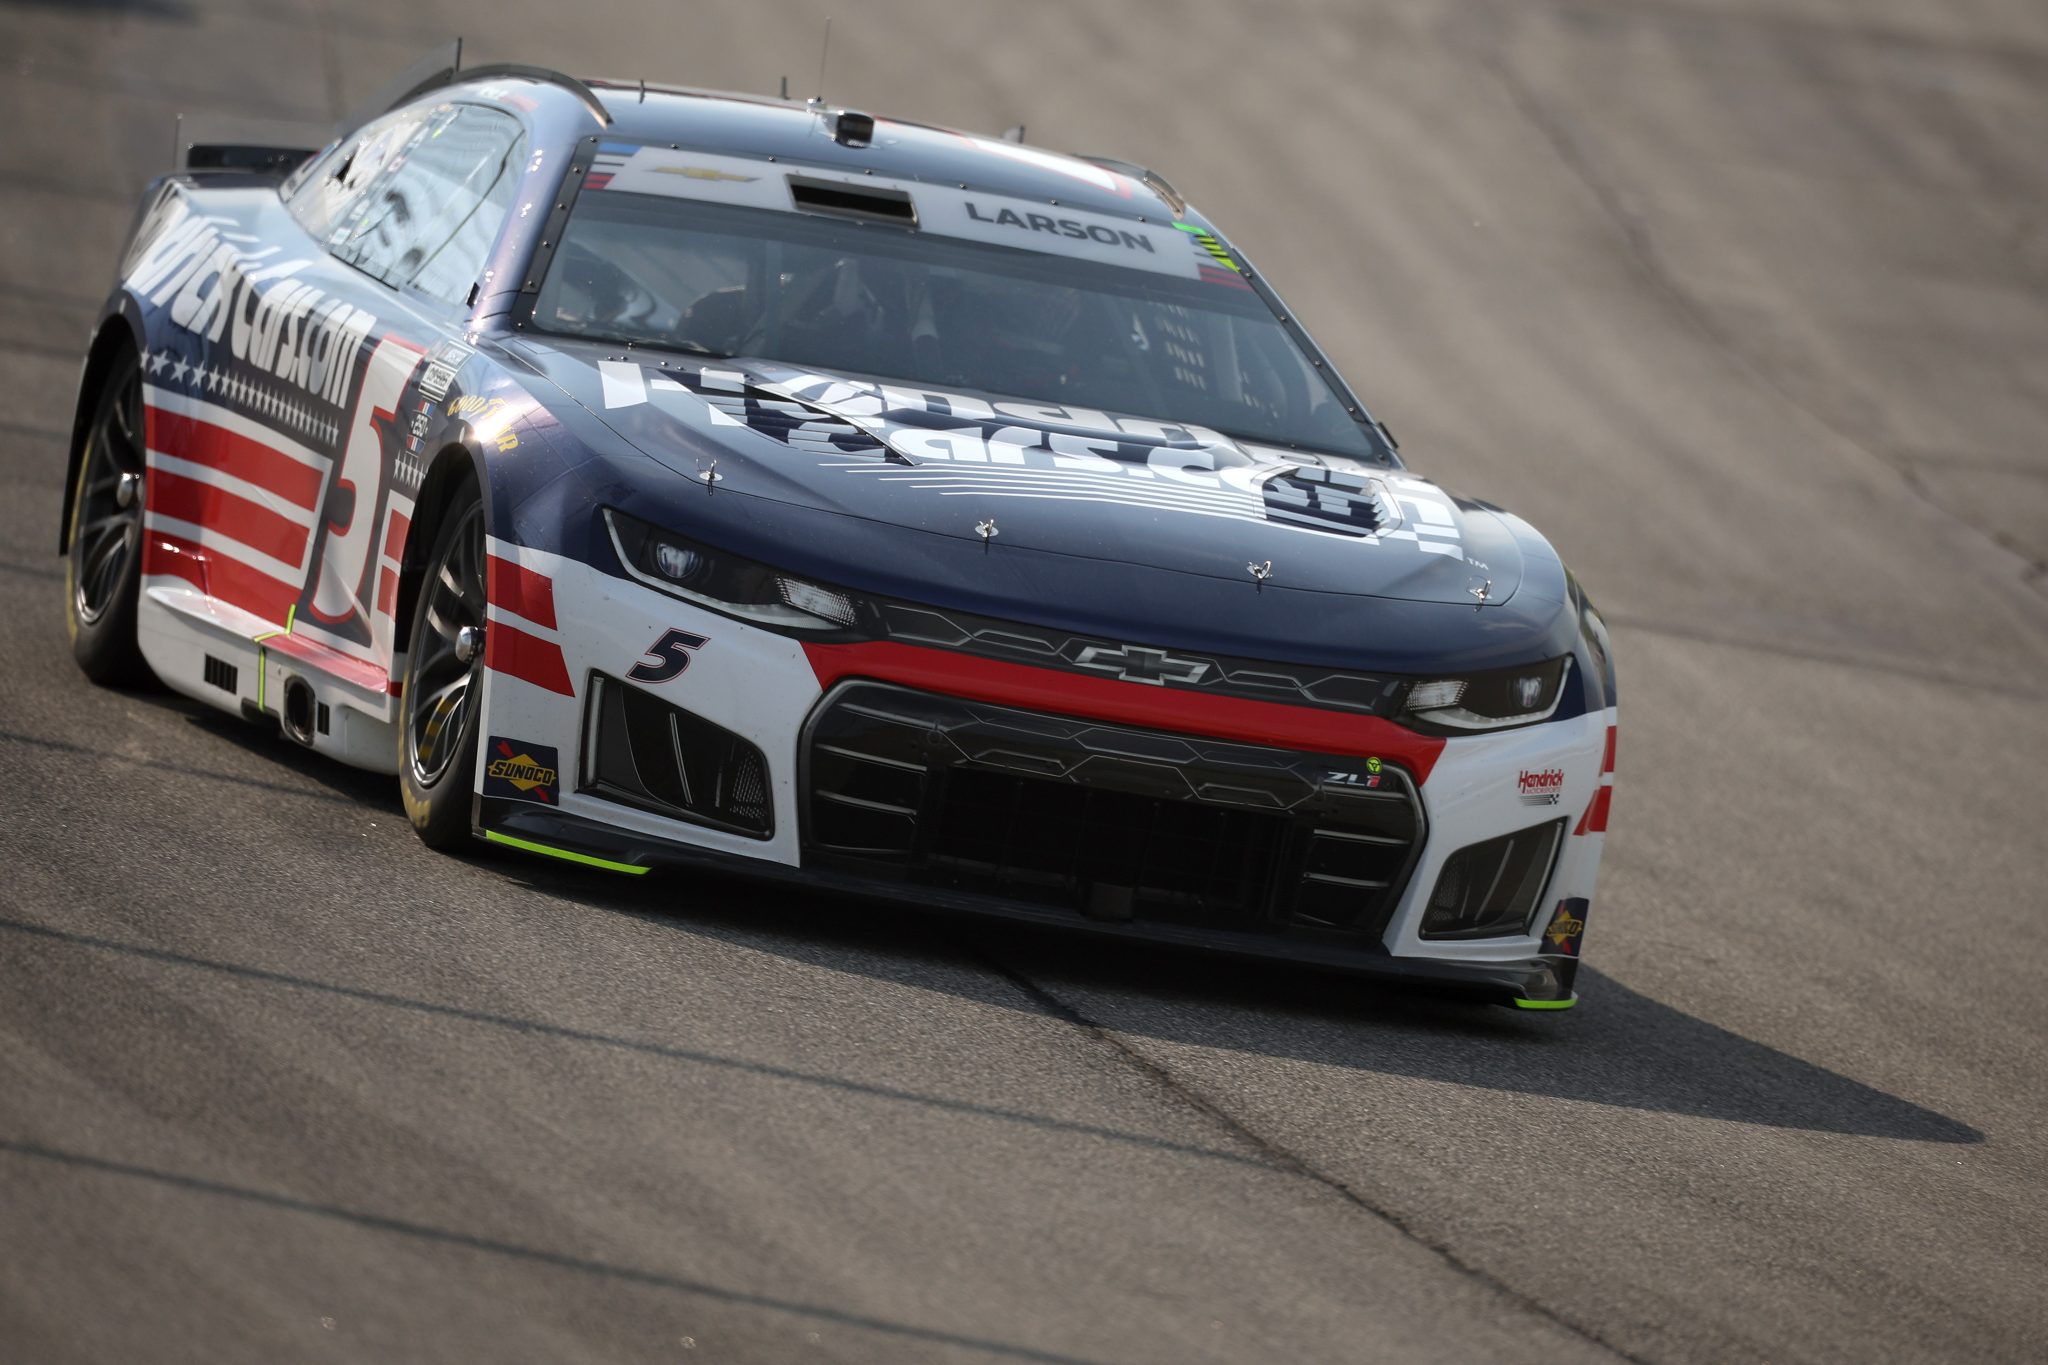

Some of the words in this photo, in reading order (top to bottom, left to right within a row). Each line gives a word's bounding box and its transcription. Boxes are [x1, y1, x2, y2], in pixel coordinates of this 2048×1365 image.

[965, 202, 1155, 253] LARSON
[309, 332, 428, 624] 5
[625, 627, 710, 684] 5
[490, 761, 553, 784] SUNOCO
[1323, 770, 1381, 788] ZL1
[1518, 768, 1564, 794] Hendrick
